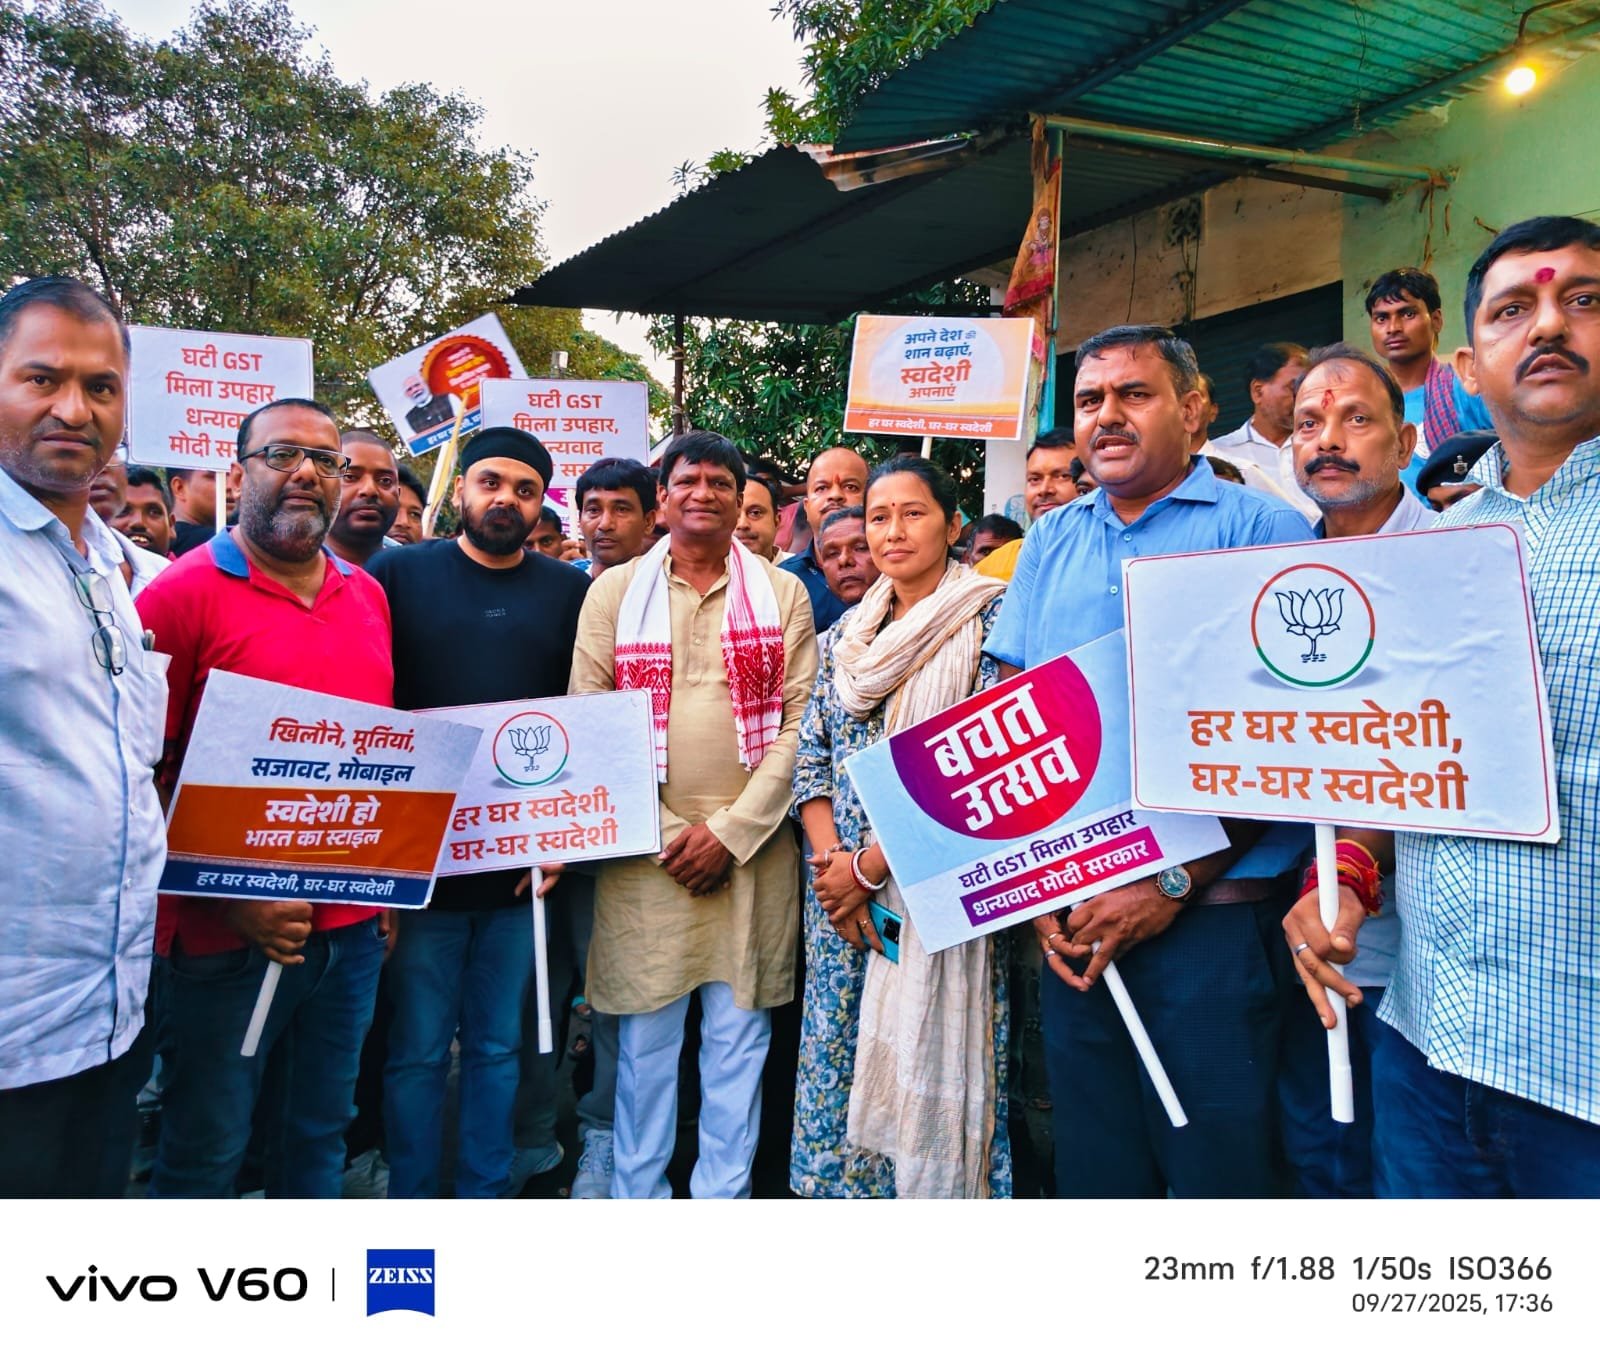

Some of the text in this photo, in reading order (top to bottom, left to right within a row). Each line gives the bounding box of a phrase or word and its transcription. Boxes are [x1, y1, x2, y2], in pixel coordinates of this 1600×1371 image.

[905, 329, 937, 344] अपने
[940, 328, 963, 342] देश
[182, 344, 262, 371] घटी GST
[905, 348, 931, 360] शान
[165, 371, 213, 398] मिला
[901, 359, 972, 384] स्वदेशी
[528, 389, 602, 408] घटी GST
[909, 384, 956, 399] अपनाएं
[513, 413, 619, 434] मिला उपहार,
[868, 418, 880, 428] हर
[960, 420, 992, 432] स्वदेशी
[169, 430, 211, 456] मोदी
[268, 717, 347, 748] खिलौने,
[924, 681, 1048, 778] बचत
[1188, 699, 1463, 754] हर घर स्वदेशी,
[251, 757, 415, 785] सजावट, मोबाइल
[951, 734, 1081, 832] उत्सव
[1189, 758, 1469, 811] घर-घर स्वदेशी
[265, 793, 381, 824] स्वदेशी हो
[451, 785, 616, 832] हर घर स्वदेशी,
[245, 828, 383, 847] भारत का स्टाइल
[450, 818, 619, 861] घर-घर स्वदेशी
[958, 809, 1137, 888] घटी GST मिला उपहार
[196, 871, 395, 897] हर घर स्वदेशी, घर-घर स्वदेशी
[972, 840, 1150, 917] धन्यवाद मोदी सरकार
